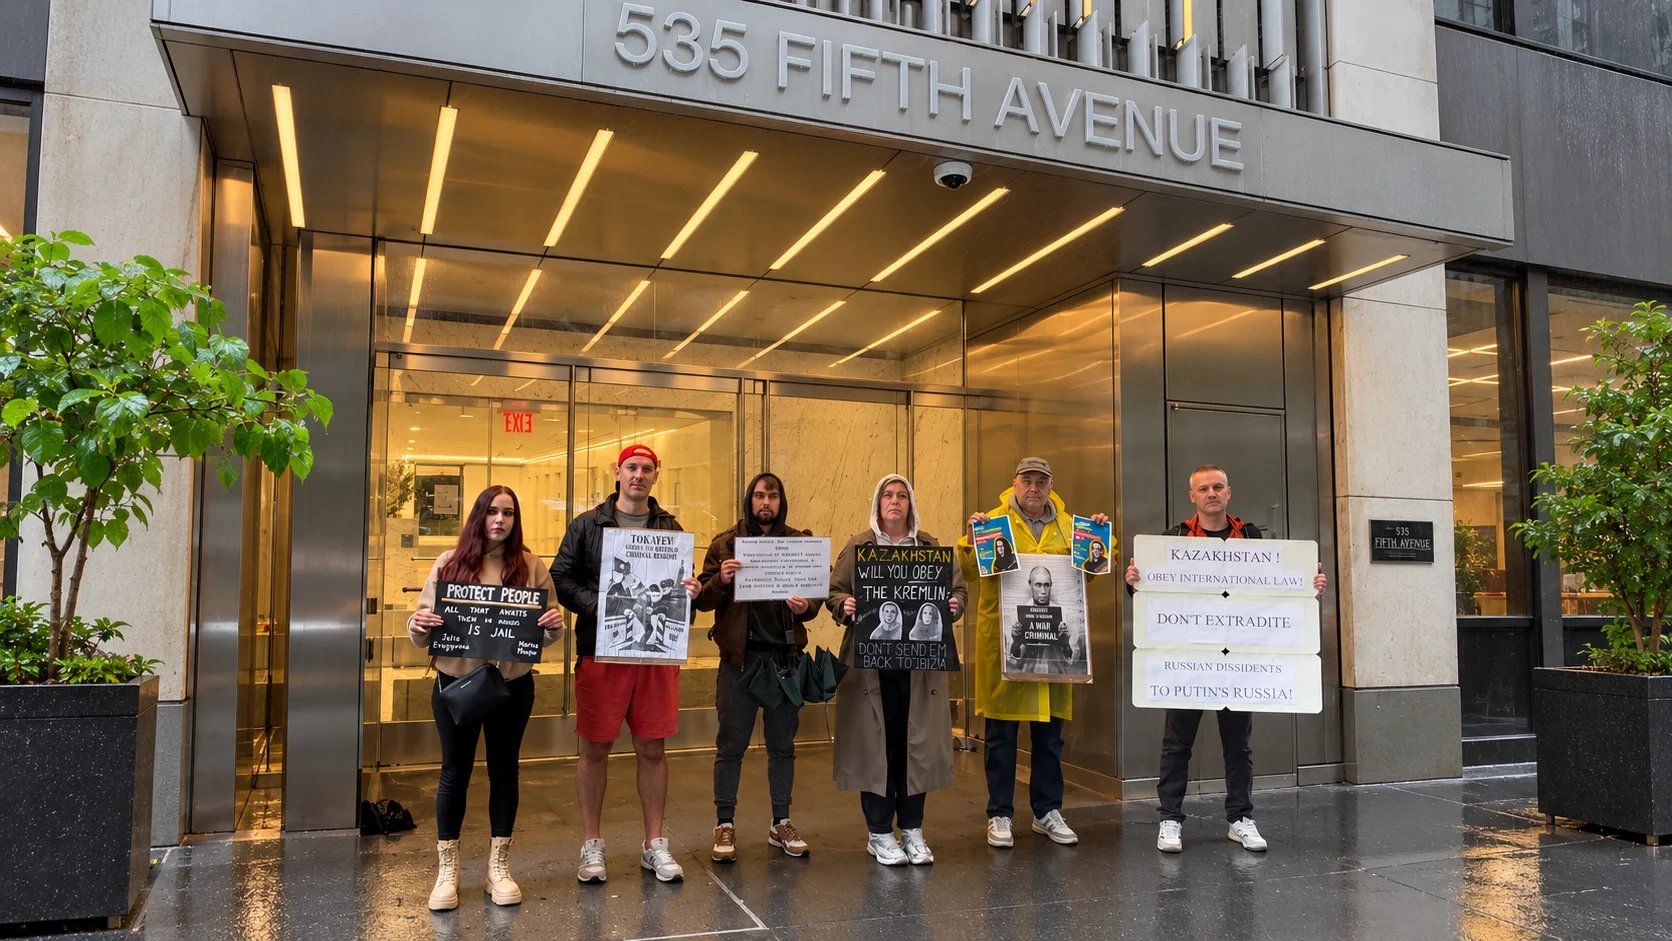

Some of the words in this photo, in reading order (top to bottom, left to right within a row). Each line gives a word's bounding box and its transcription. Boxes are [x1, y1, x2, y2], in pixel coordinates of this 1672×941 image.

[614, 1, 750, 80] 535
[778, 30, 972, 123] FIFTH
[994, 77, 1245, 172] AVENUE
[1375, 537, 1397, 549] FIFTH
[1400, 538, 1431, 549] AVENUE
[857, 548, 951, 563] KAZAKHSTAN
[1171, 549, 1272, 563] KAZAKHSTAN
[858, 565, 884, 579] WILL
[887, 564, 908, 579] YOU
[912, 564, 943, 580] OBEY
[1147, 572, 1177, 583] OBEY
[1179, 574, 1270, 586] INTERNATIONAL
[1273, 577, 1303, 587] LAW!
[446, 584, 496, 600] PROTECT
[500, 587, 540, 605] PEOPLE
[862, 585, 888, 602] THE
[444, 606, 459, 614] ALL
[469, 606, 490, 615] THAT
[1035, 621, 1051, 631] WAR
[1157, 613, 1202, 626] DON'T
[1205, 614, 1291, 629] EXTRADITE
[467, 624, 480, 636] IS
[490, 627, 515, 639] JAIL
[859, 642, 892, 655] DON'T
[895, 643, 927, 657] SEND
[863, 655, 892, 669] BACK
[1164, 661, 1213, 671] RUSSIAN
[1216, 662, 1282, 673] DISSIDENTS
[1150, 685, 1170, 697] TO
[1174, 686, 1229, 699] PUTIN'S
[1234, 687, 1293, 700] RUSSIA!
